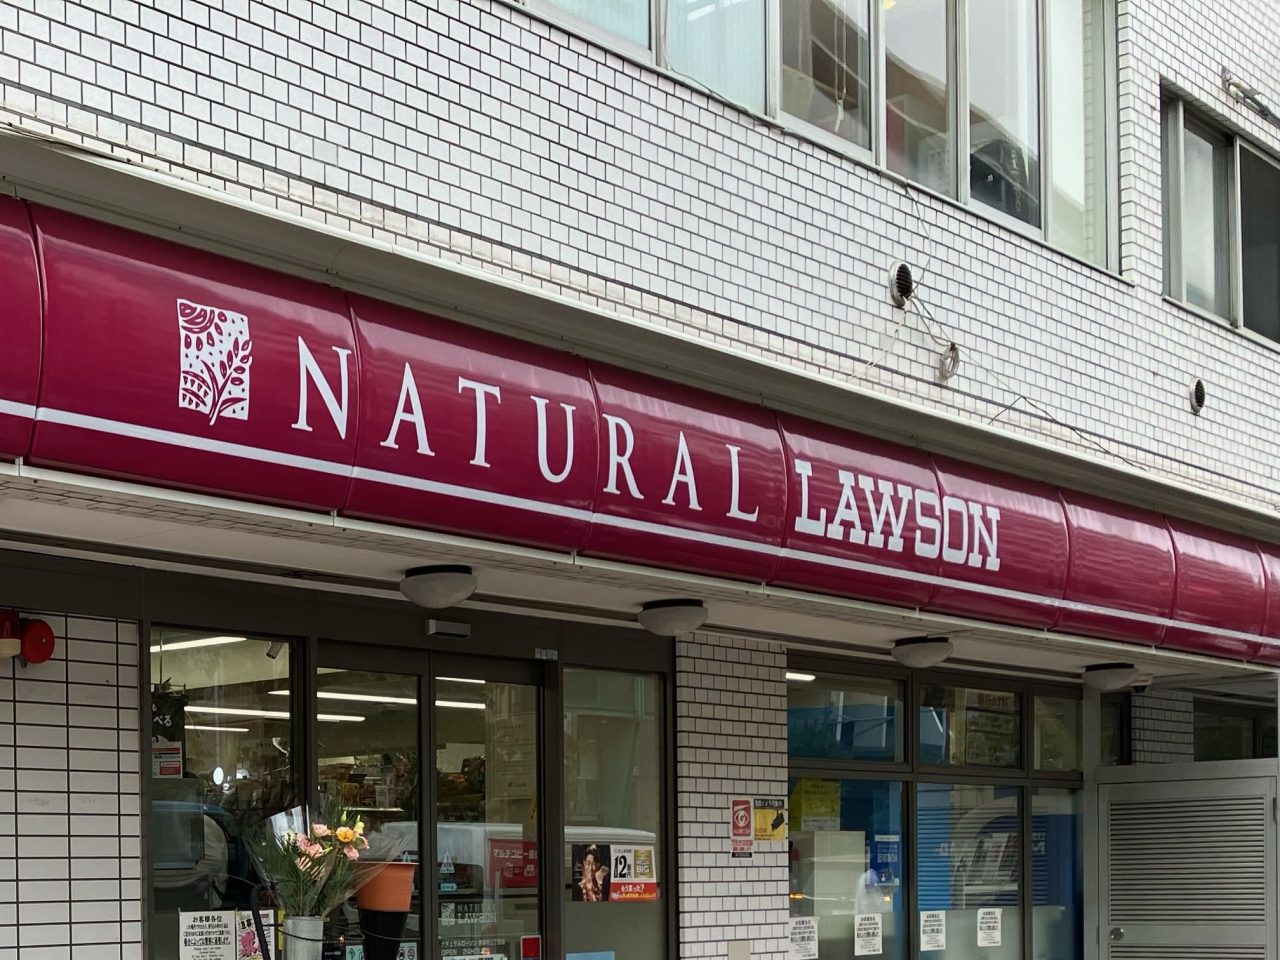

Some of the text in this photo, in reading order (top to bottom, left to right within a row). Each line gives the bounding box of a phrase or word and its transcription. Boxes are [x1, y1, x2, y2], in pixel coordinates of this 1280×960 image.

[291, 334, 1001, 572] NATURAL LAWSON
[614, 855, 627, 878] 12
[636, 865, 650, 873] BIG
[441, 949, 457, 957] OPEN
